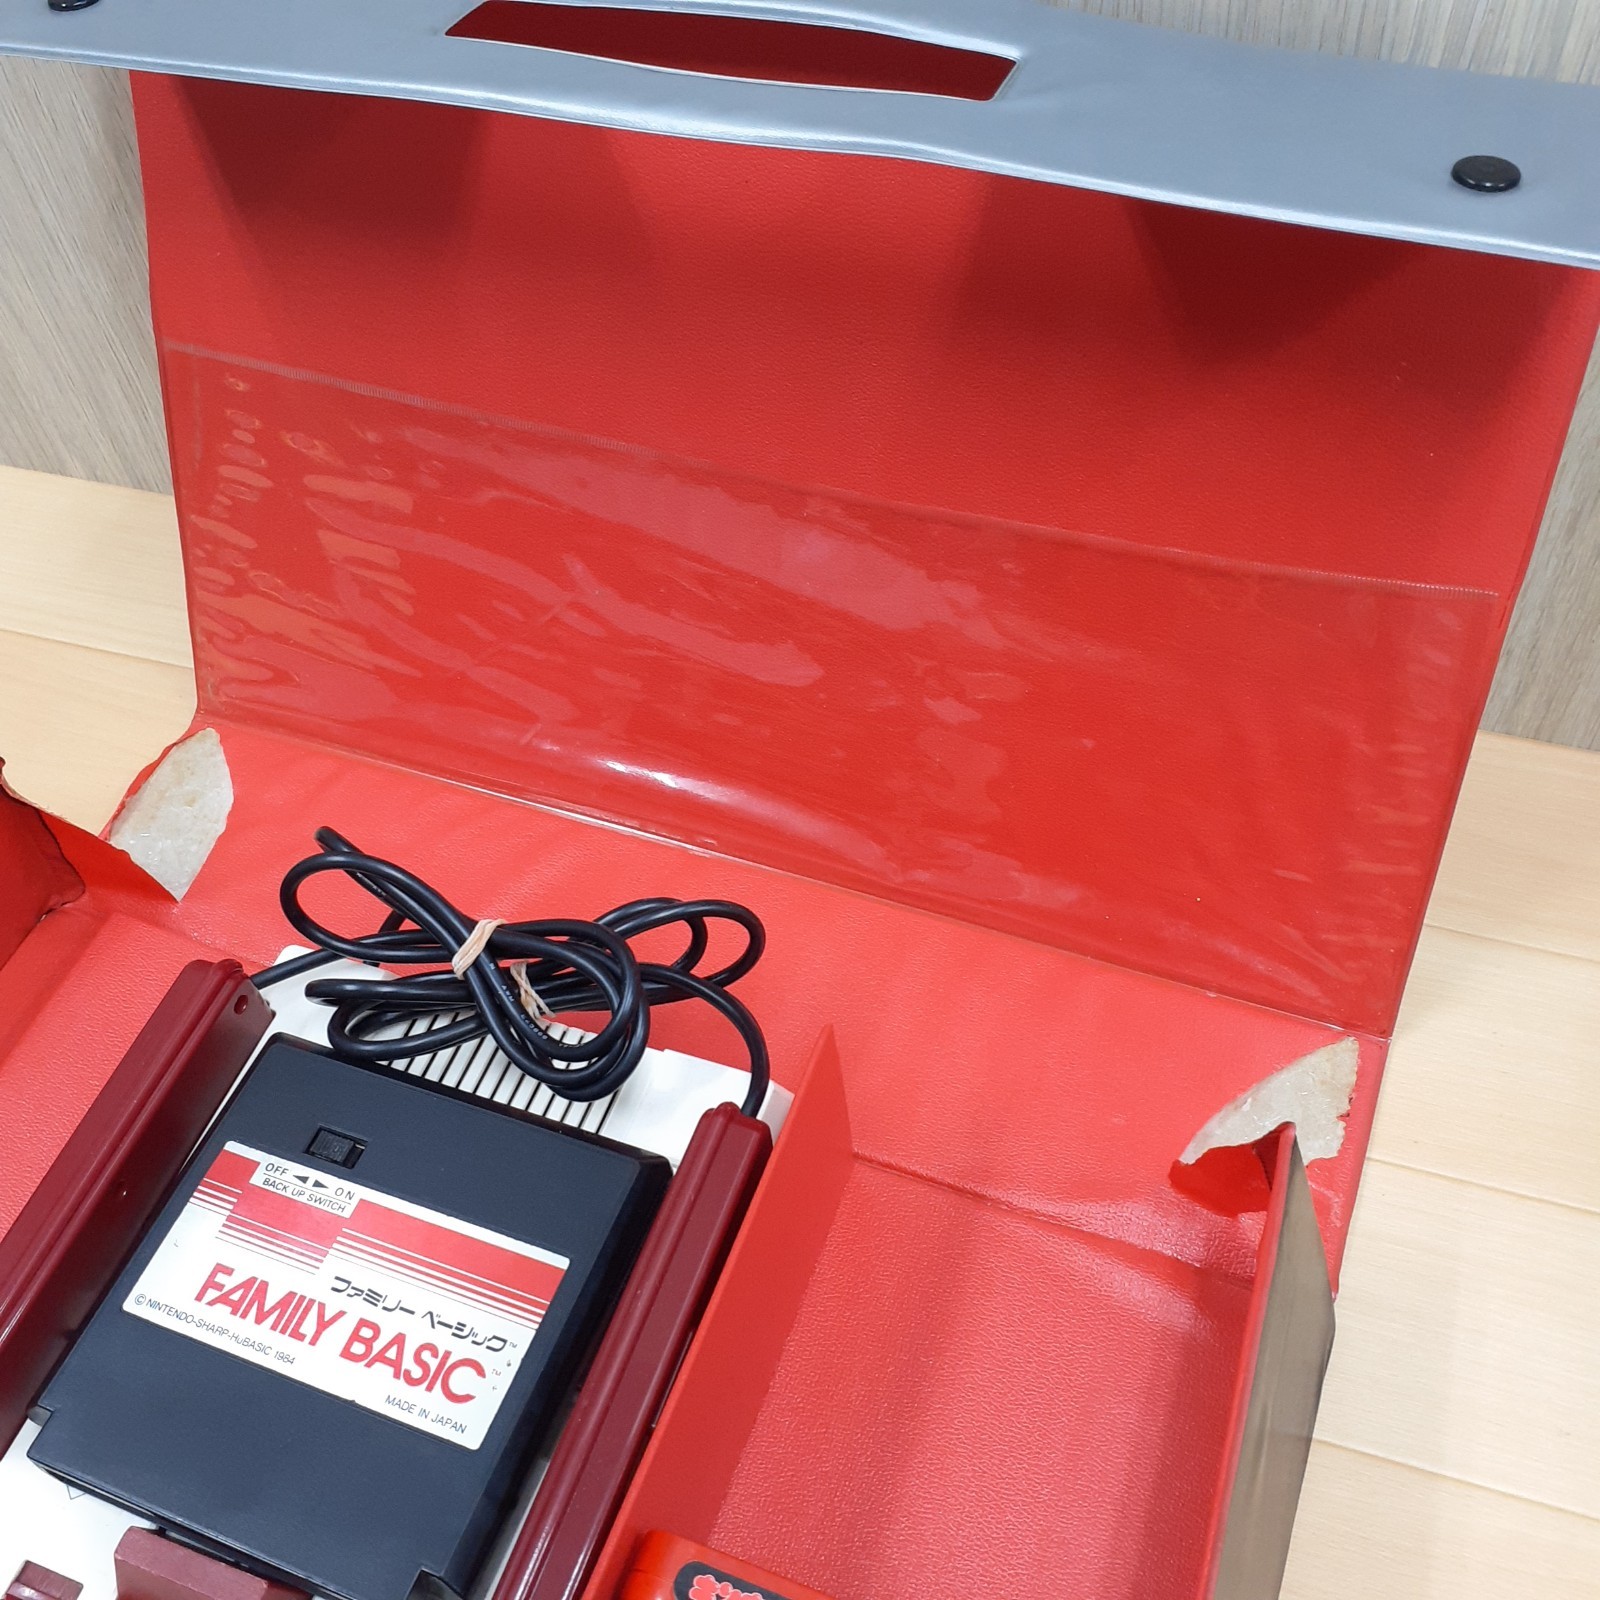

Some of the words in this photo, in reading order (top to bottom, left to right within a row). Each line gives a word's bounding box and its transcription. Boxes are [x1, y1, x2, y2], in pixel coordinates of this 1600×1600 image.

[262, 1177, 289, 1193] BACK
[291, 1188, 306, 1197] UP
[306, 1193, 346, 1213] SWITCH
[265, 1162, 289, 1176] OFF
[334, 1187, 355, 1201] ON
[194, 1262, 348, 1347] FAMILY
[339, 1317, 487, 1404] BASIC
[330, 1275, 415, 1315] ファミリー
[421, 1310, 508, 1353] ベーシック
[273, 1350, 296, 1365] 1984
[384, 1394, 417, 1414] MADE
[418, 1407, 430, 1419] IN
[431, 1413, 468, 1434] JAPAN
